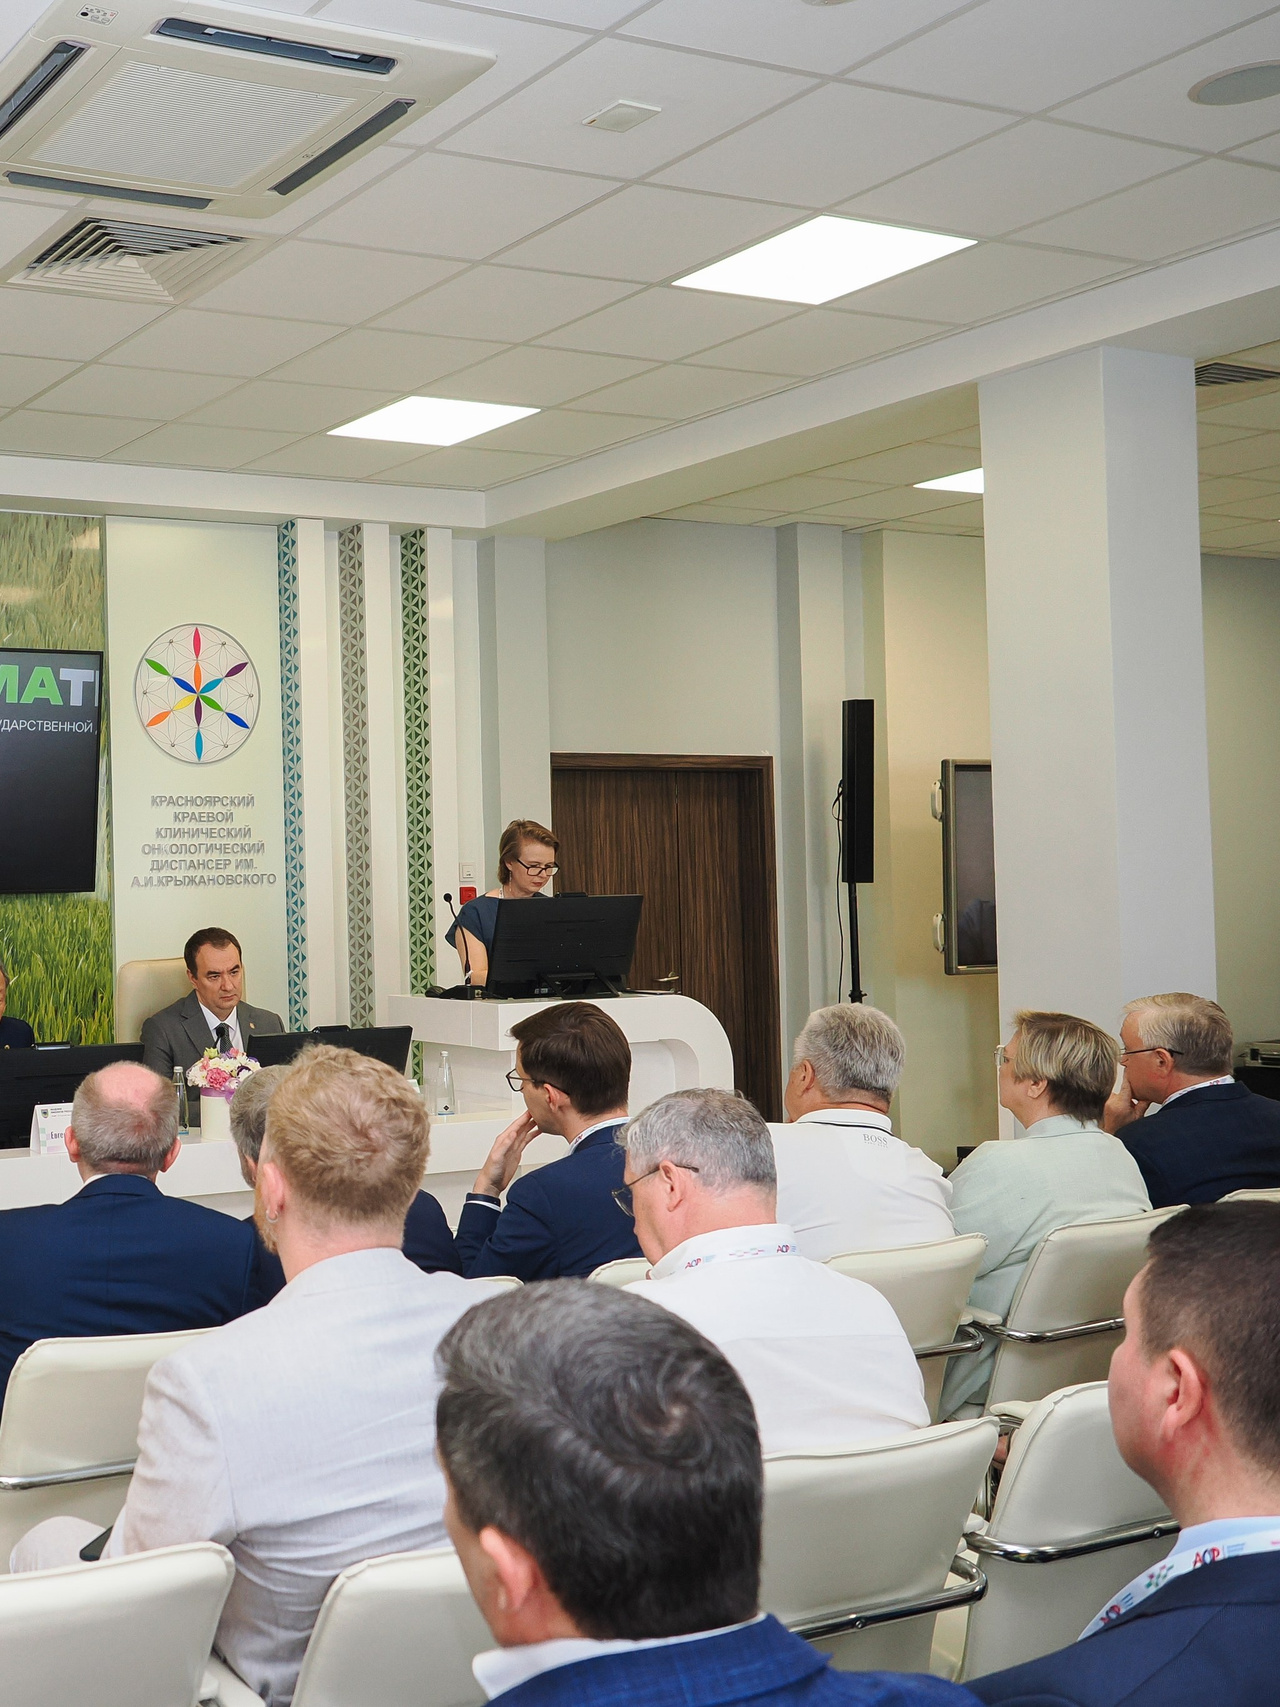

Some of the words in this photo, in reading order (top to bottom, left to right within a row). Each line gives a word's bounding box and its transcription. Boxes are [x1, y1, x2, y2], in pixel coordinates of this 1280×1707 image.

[151, 793, 255, 807] КРАСНОЯРСКИЙ
[173, 809, 234, 823] КРАЕВОЙ
[156, 825, 252, 839] КЛИНИЧЕСКИЙ
[141, 840, 265, 855] ОНКОЛОГИЧЕСКИЙ
[150, 859, 232, 873] ДИСПАНСЕР
[235, 859, 258, 870] ИМ.
[131, 873, 277, 888] А.И.КРЫЖАНОВСКОГО
[50, 1131, 65, 1140] Евге
